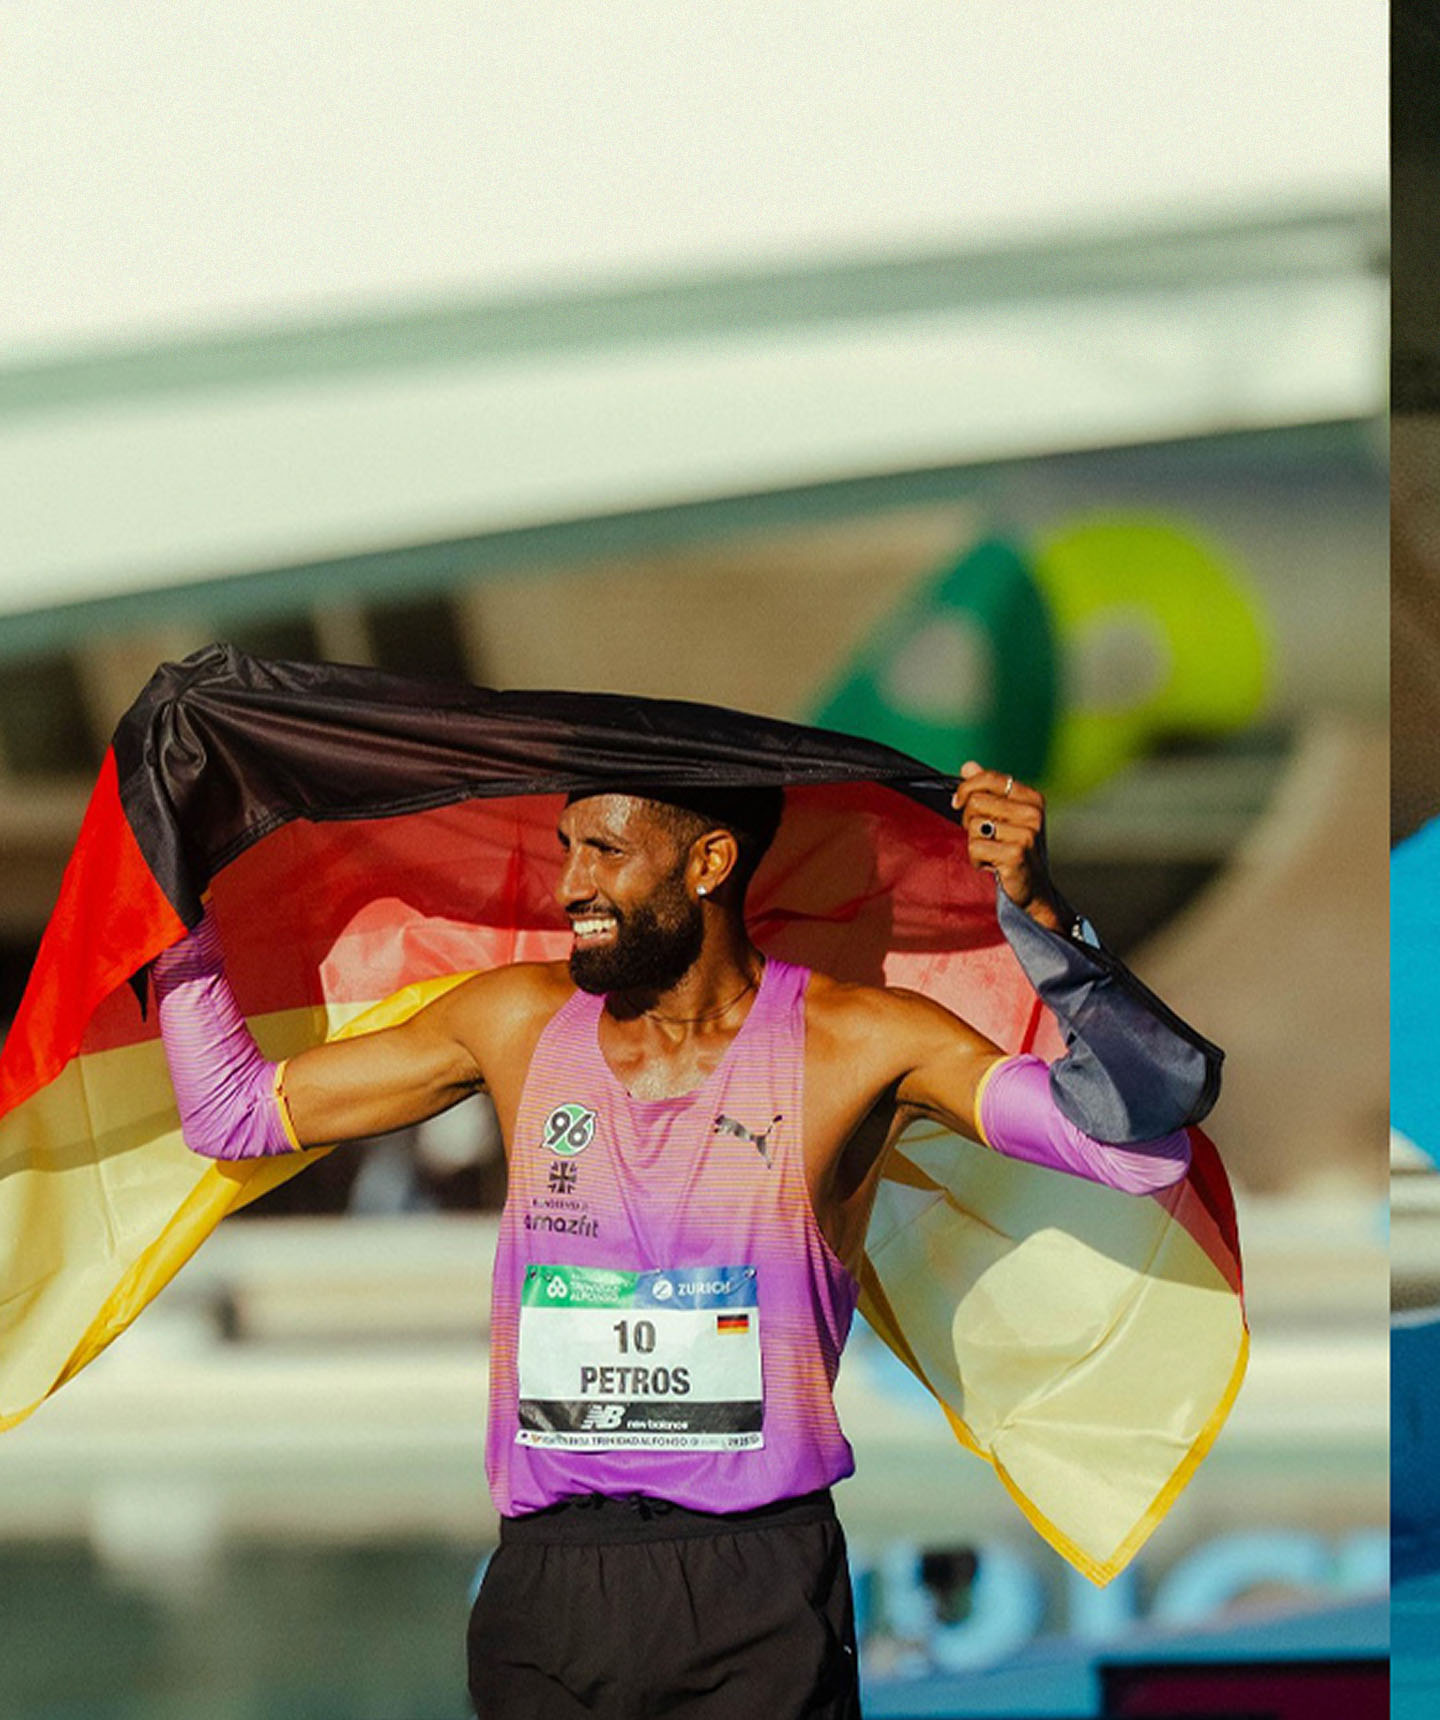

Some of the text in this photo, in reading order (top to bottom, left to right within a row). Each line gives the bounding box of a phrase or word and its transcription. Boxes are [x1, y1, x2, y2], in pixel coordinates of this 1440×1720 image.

[542, 1110, 596, 1149] 96
[677, 1281, 732, 1296] ZURICH
[613, 1320, 656, 1354] 10
[580, 1366, 690, 1396] PETROS
